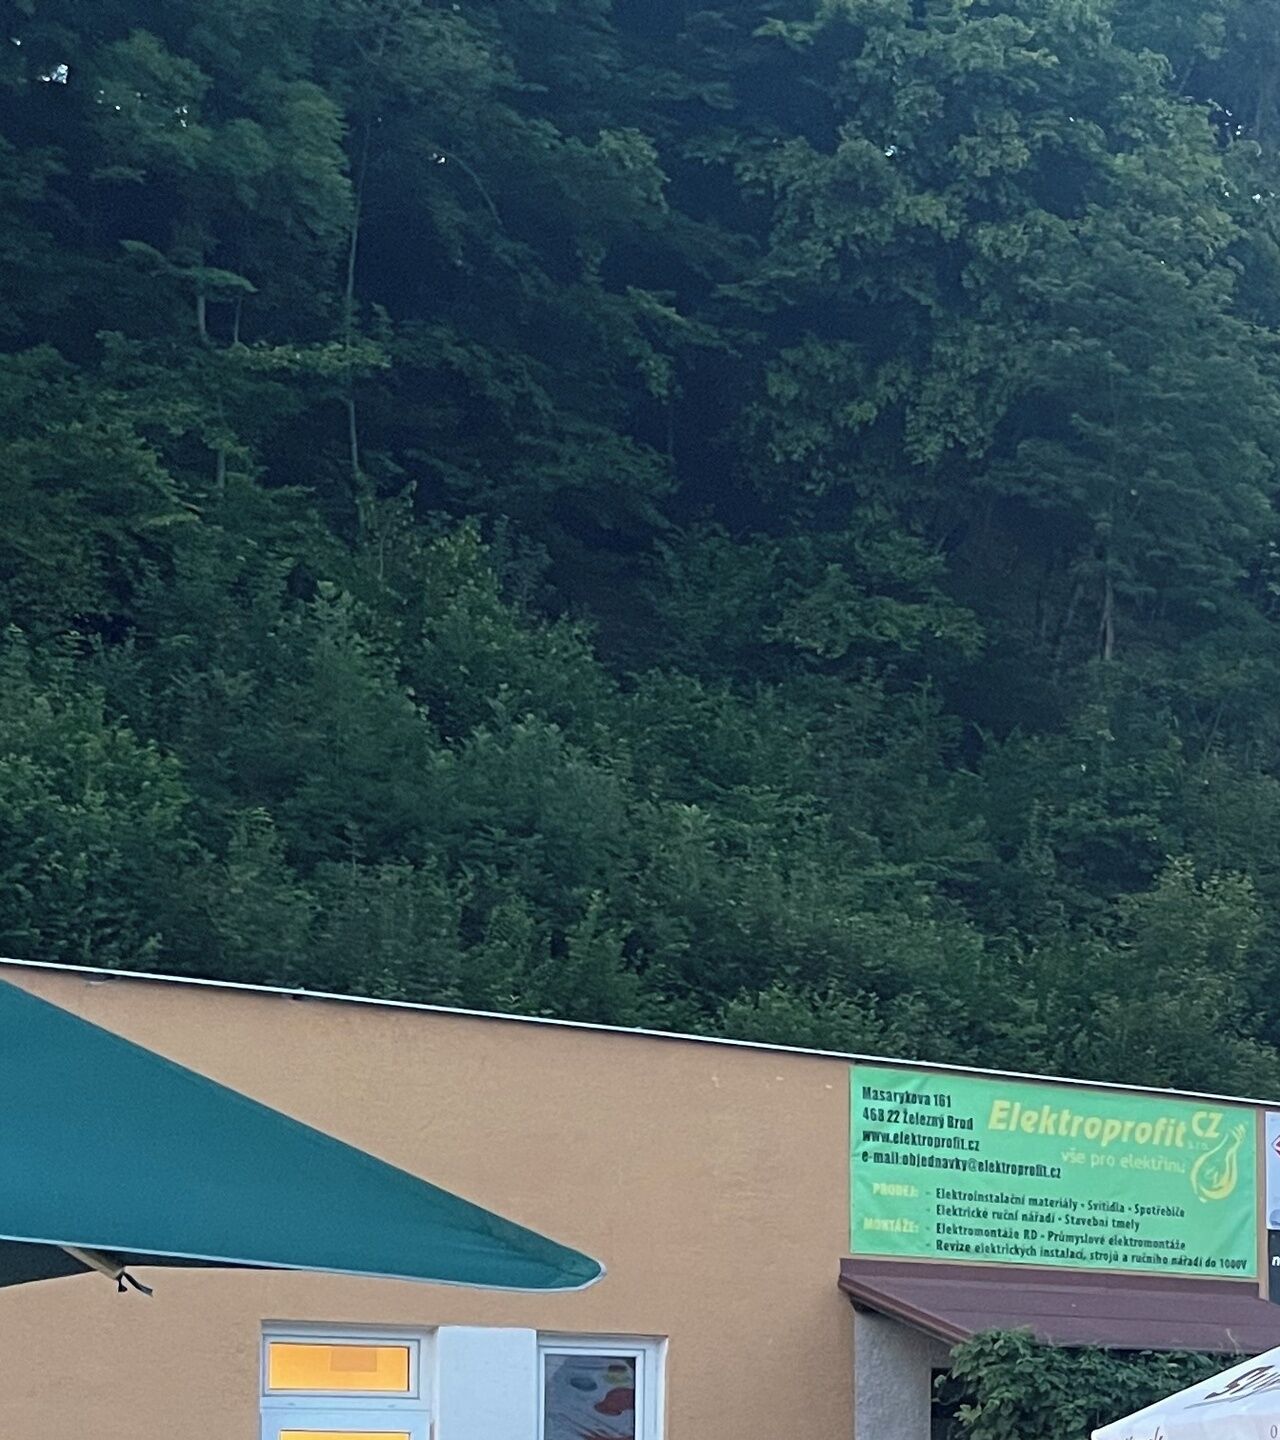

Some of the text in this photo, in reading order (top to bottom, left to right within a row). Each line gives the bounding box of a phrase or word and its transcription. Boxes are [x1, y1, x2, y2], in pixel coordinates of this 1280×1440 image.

[862, 1086, 951, 1108] Masarykova 161
[863, 1107, 884, 1122] 468
[887, 1110, 900, 1124] 22
[948, 1116, 974, 1130] Brod
[988, 1099, 1224, 1147] Elektroprofit CZ
[862, 1130, 980, 1151] www.elektroprofit.cz
[1091, 1151, 1115, 1168] pro
[1024, 1230, 1038, 1240] RD
